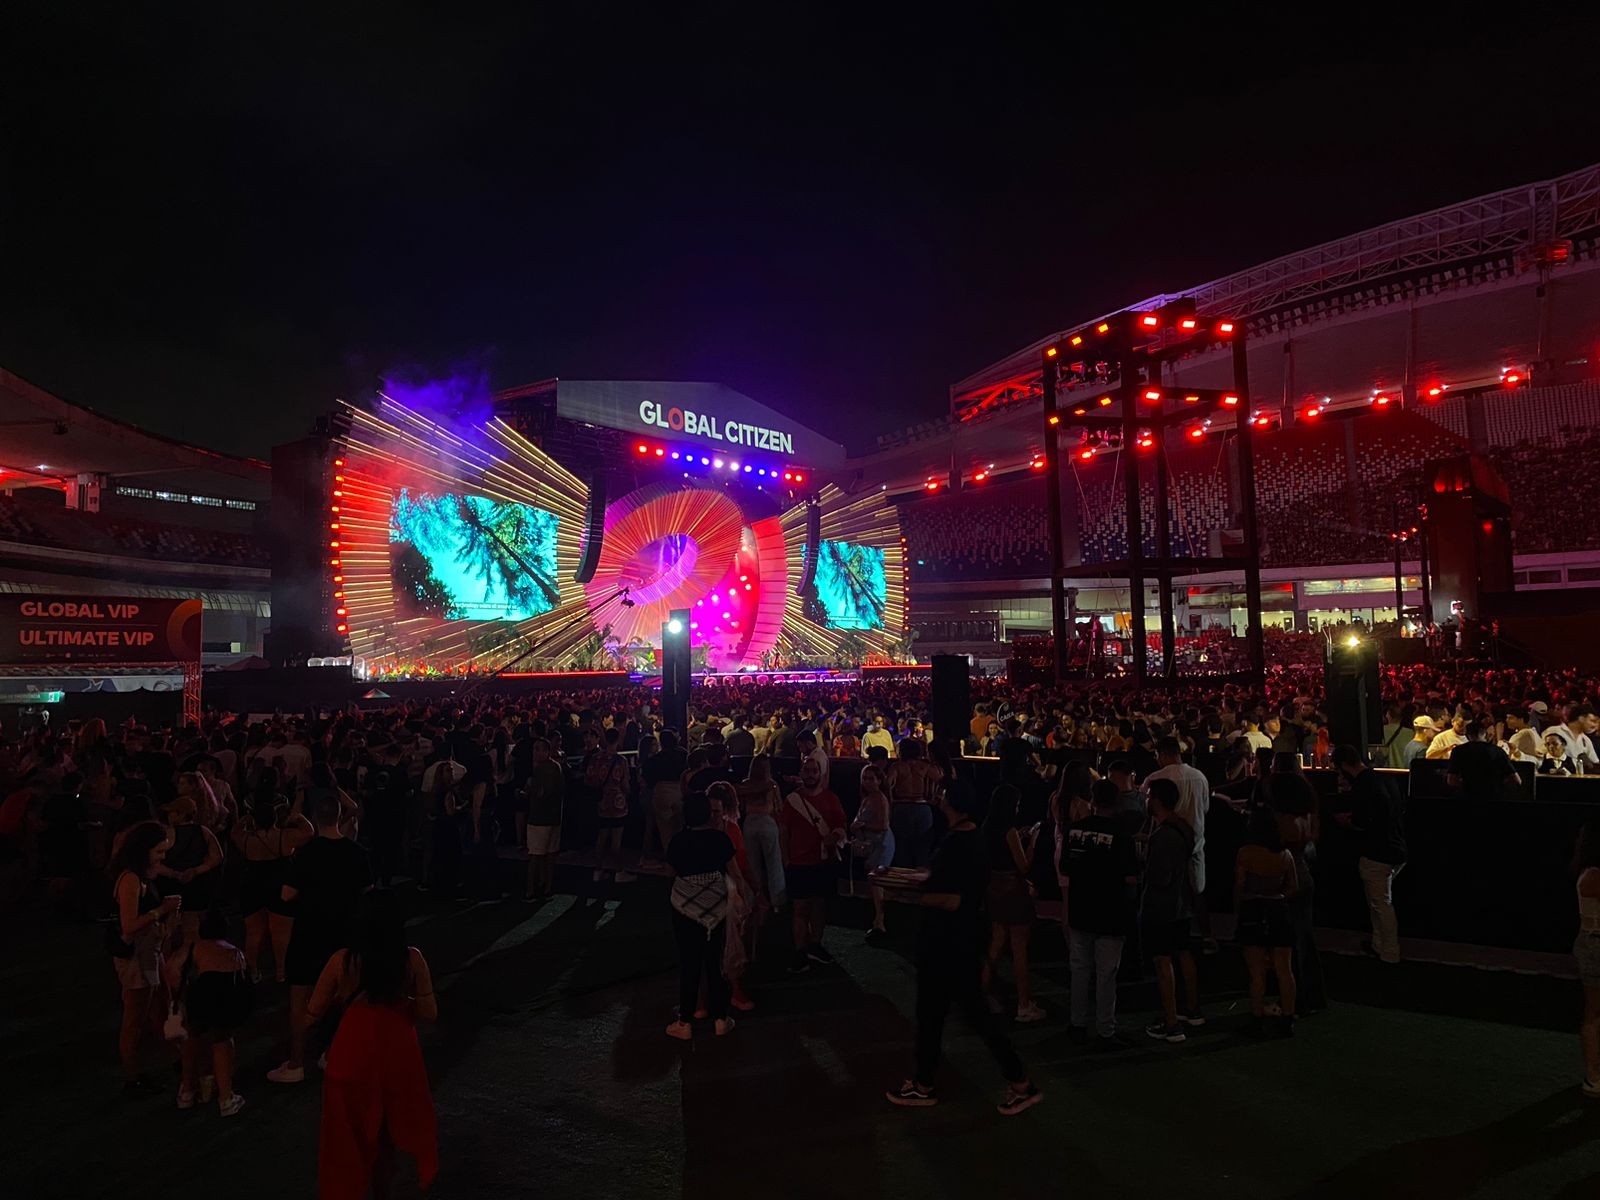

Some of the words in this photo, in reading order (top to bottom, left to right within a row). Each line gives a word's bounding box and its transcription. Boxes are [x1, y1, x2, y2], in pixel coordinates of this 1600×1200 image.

[639, 400, 722, 440] GLOBAL
[20, 601, 104, 618] GLOBAL
[107, 604, 140, 618] VIP
[20, 630, 119, 647] ULTIMATE
[124, 632, 155, 647] VIP
